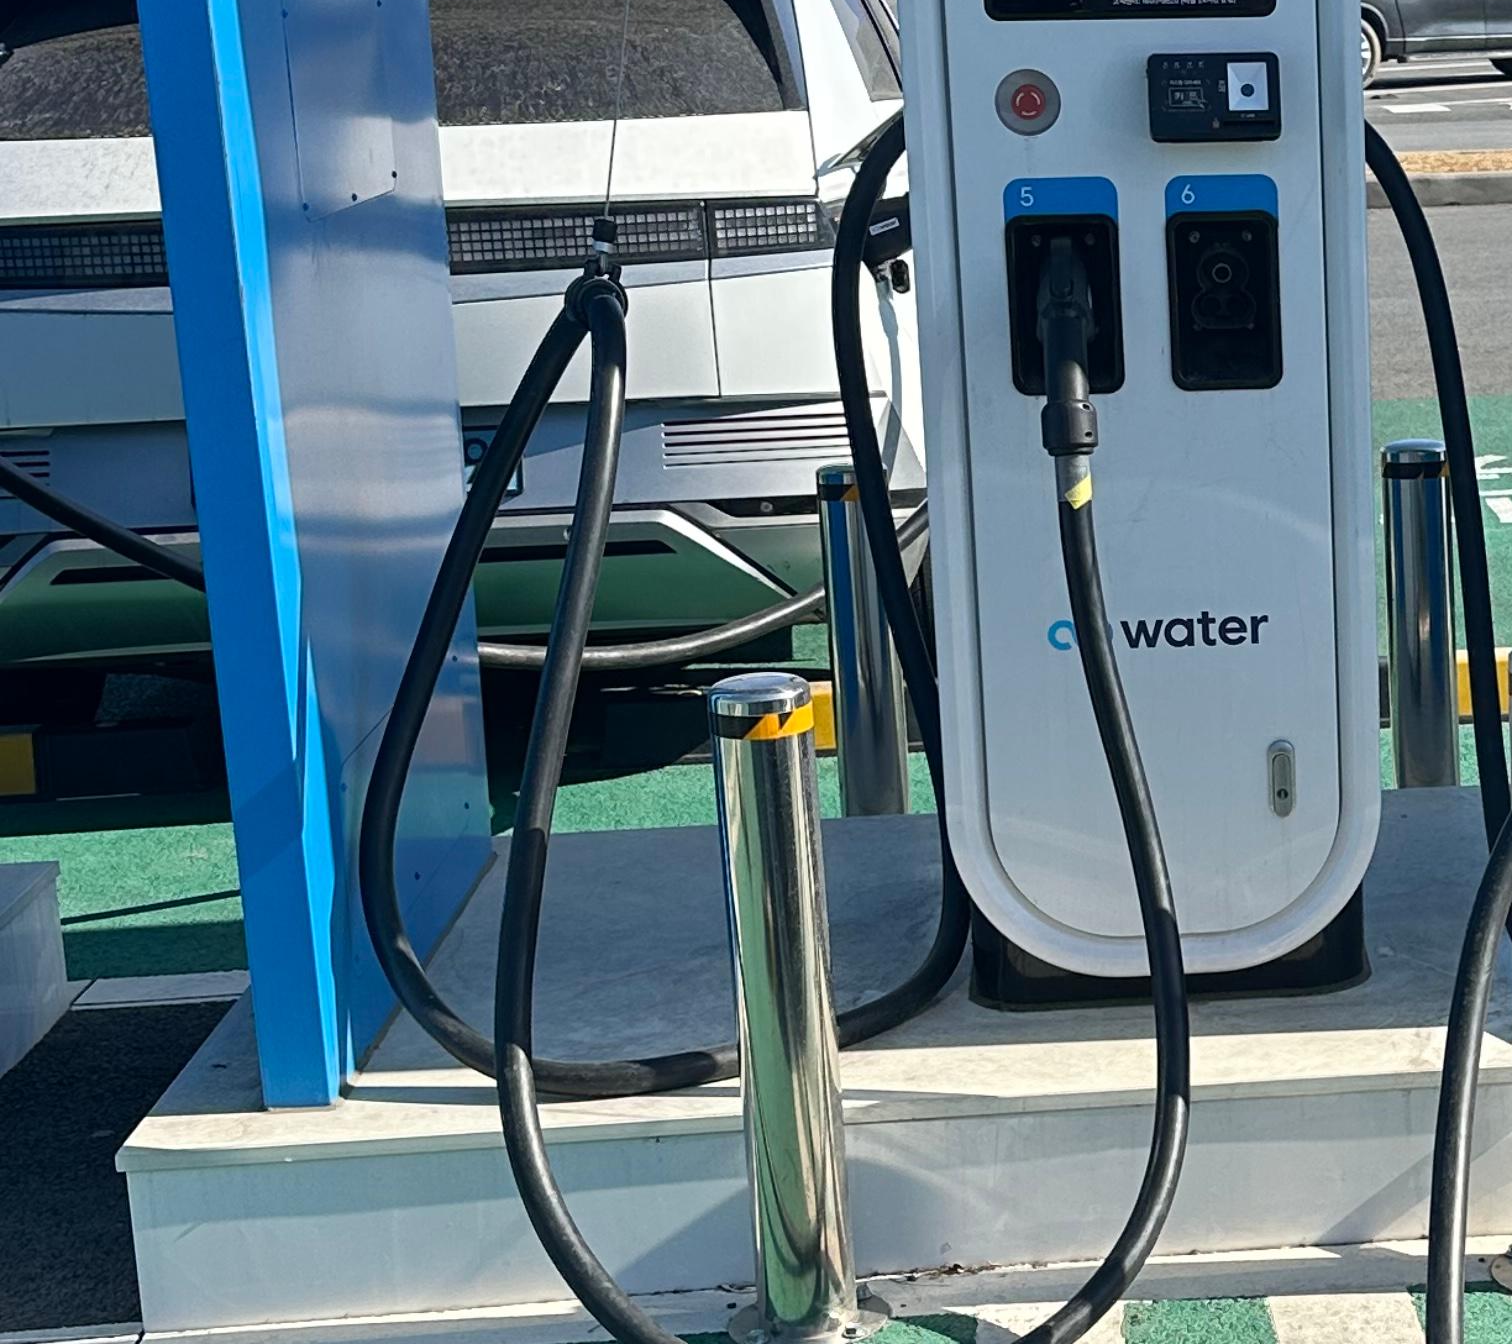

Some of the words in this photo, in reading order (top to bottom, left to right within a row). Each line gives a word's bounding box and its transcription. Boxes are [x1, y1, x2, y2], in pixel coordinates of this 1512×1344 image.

[1019, 186, 1034, 207] 5
[1181, 183, 1196, 205] 6
[1120, 610, 1269, 649] water
